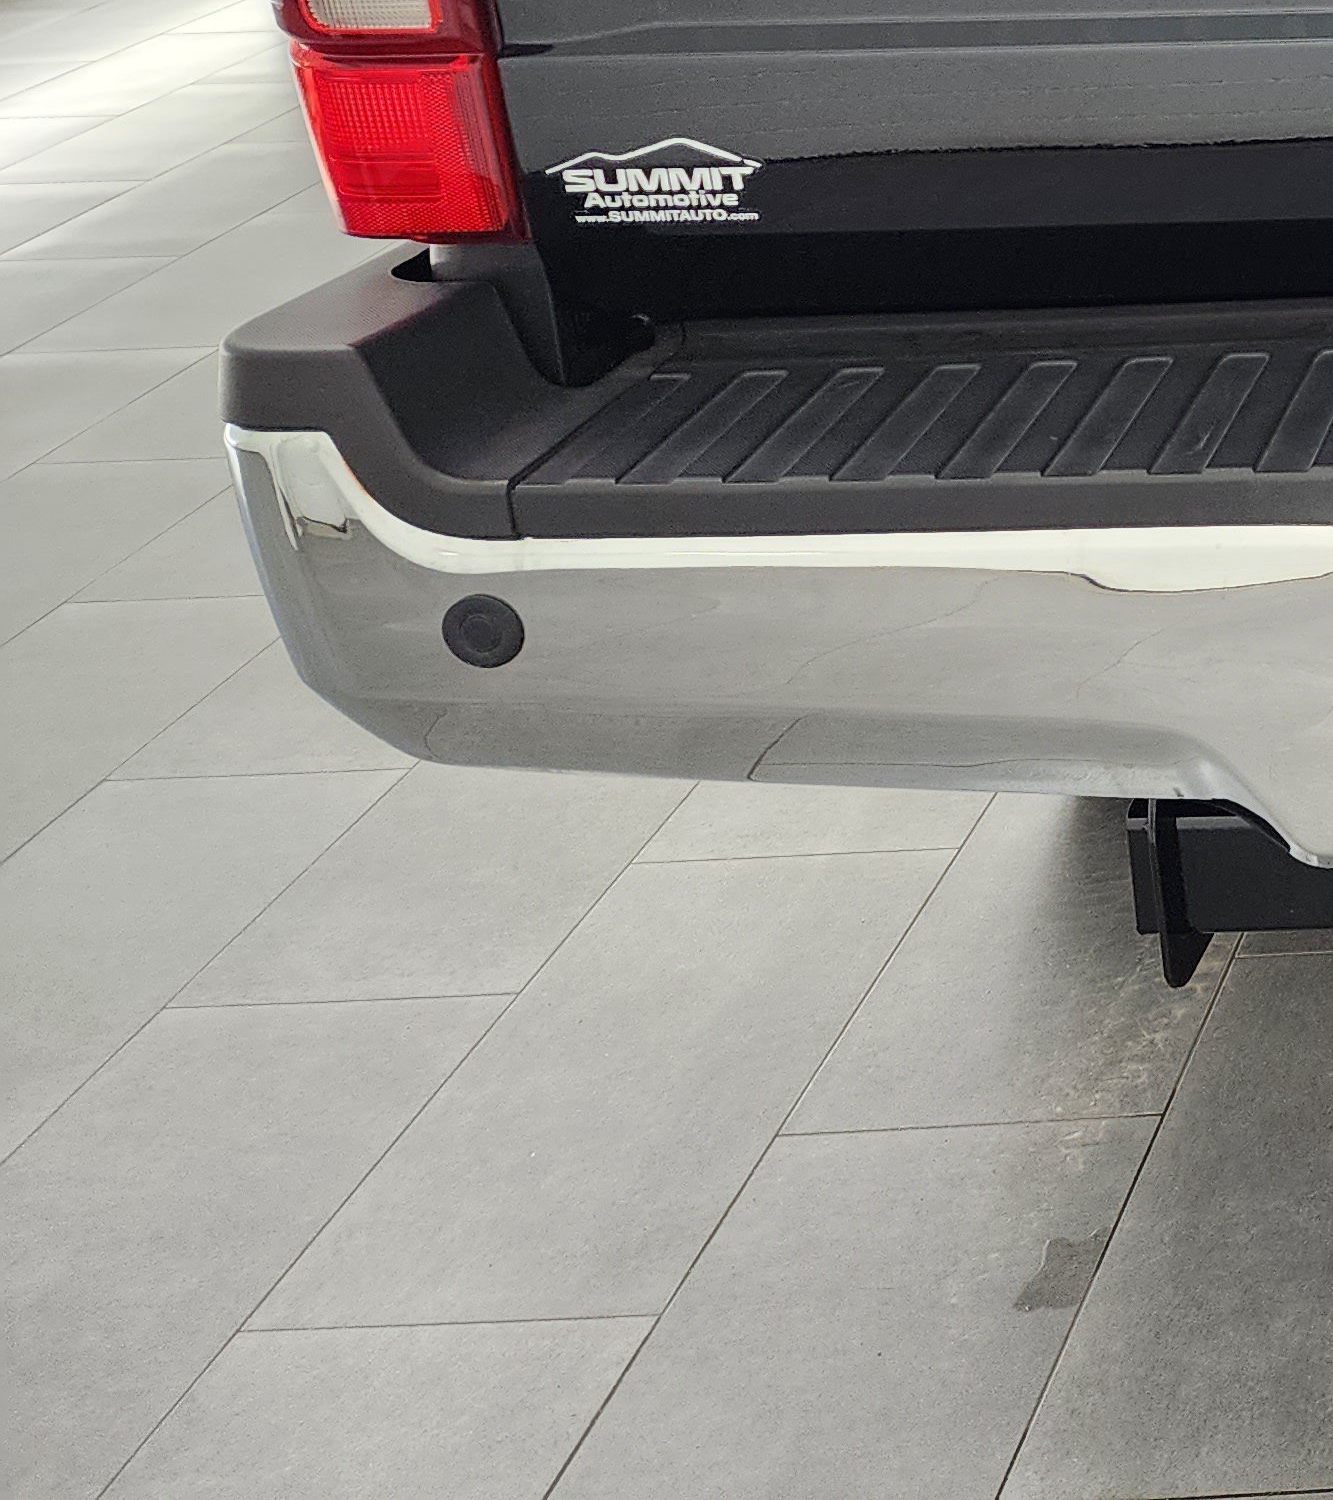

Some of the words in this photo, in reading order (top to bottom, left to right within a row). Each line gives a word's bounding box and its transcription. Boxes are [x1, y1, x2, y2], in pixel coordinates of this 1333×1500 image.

[562, 167, 754, 192] SUMMIT
[584, 190, 739, 208] Automotive
[575, 209, 759, 223] www.SUMMITAUTO.com
